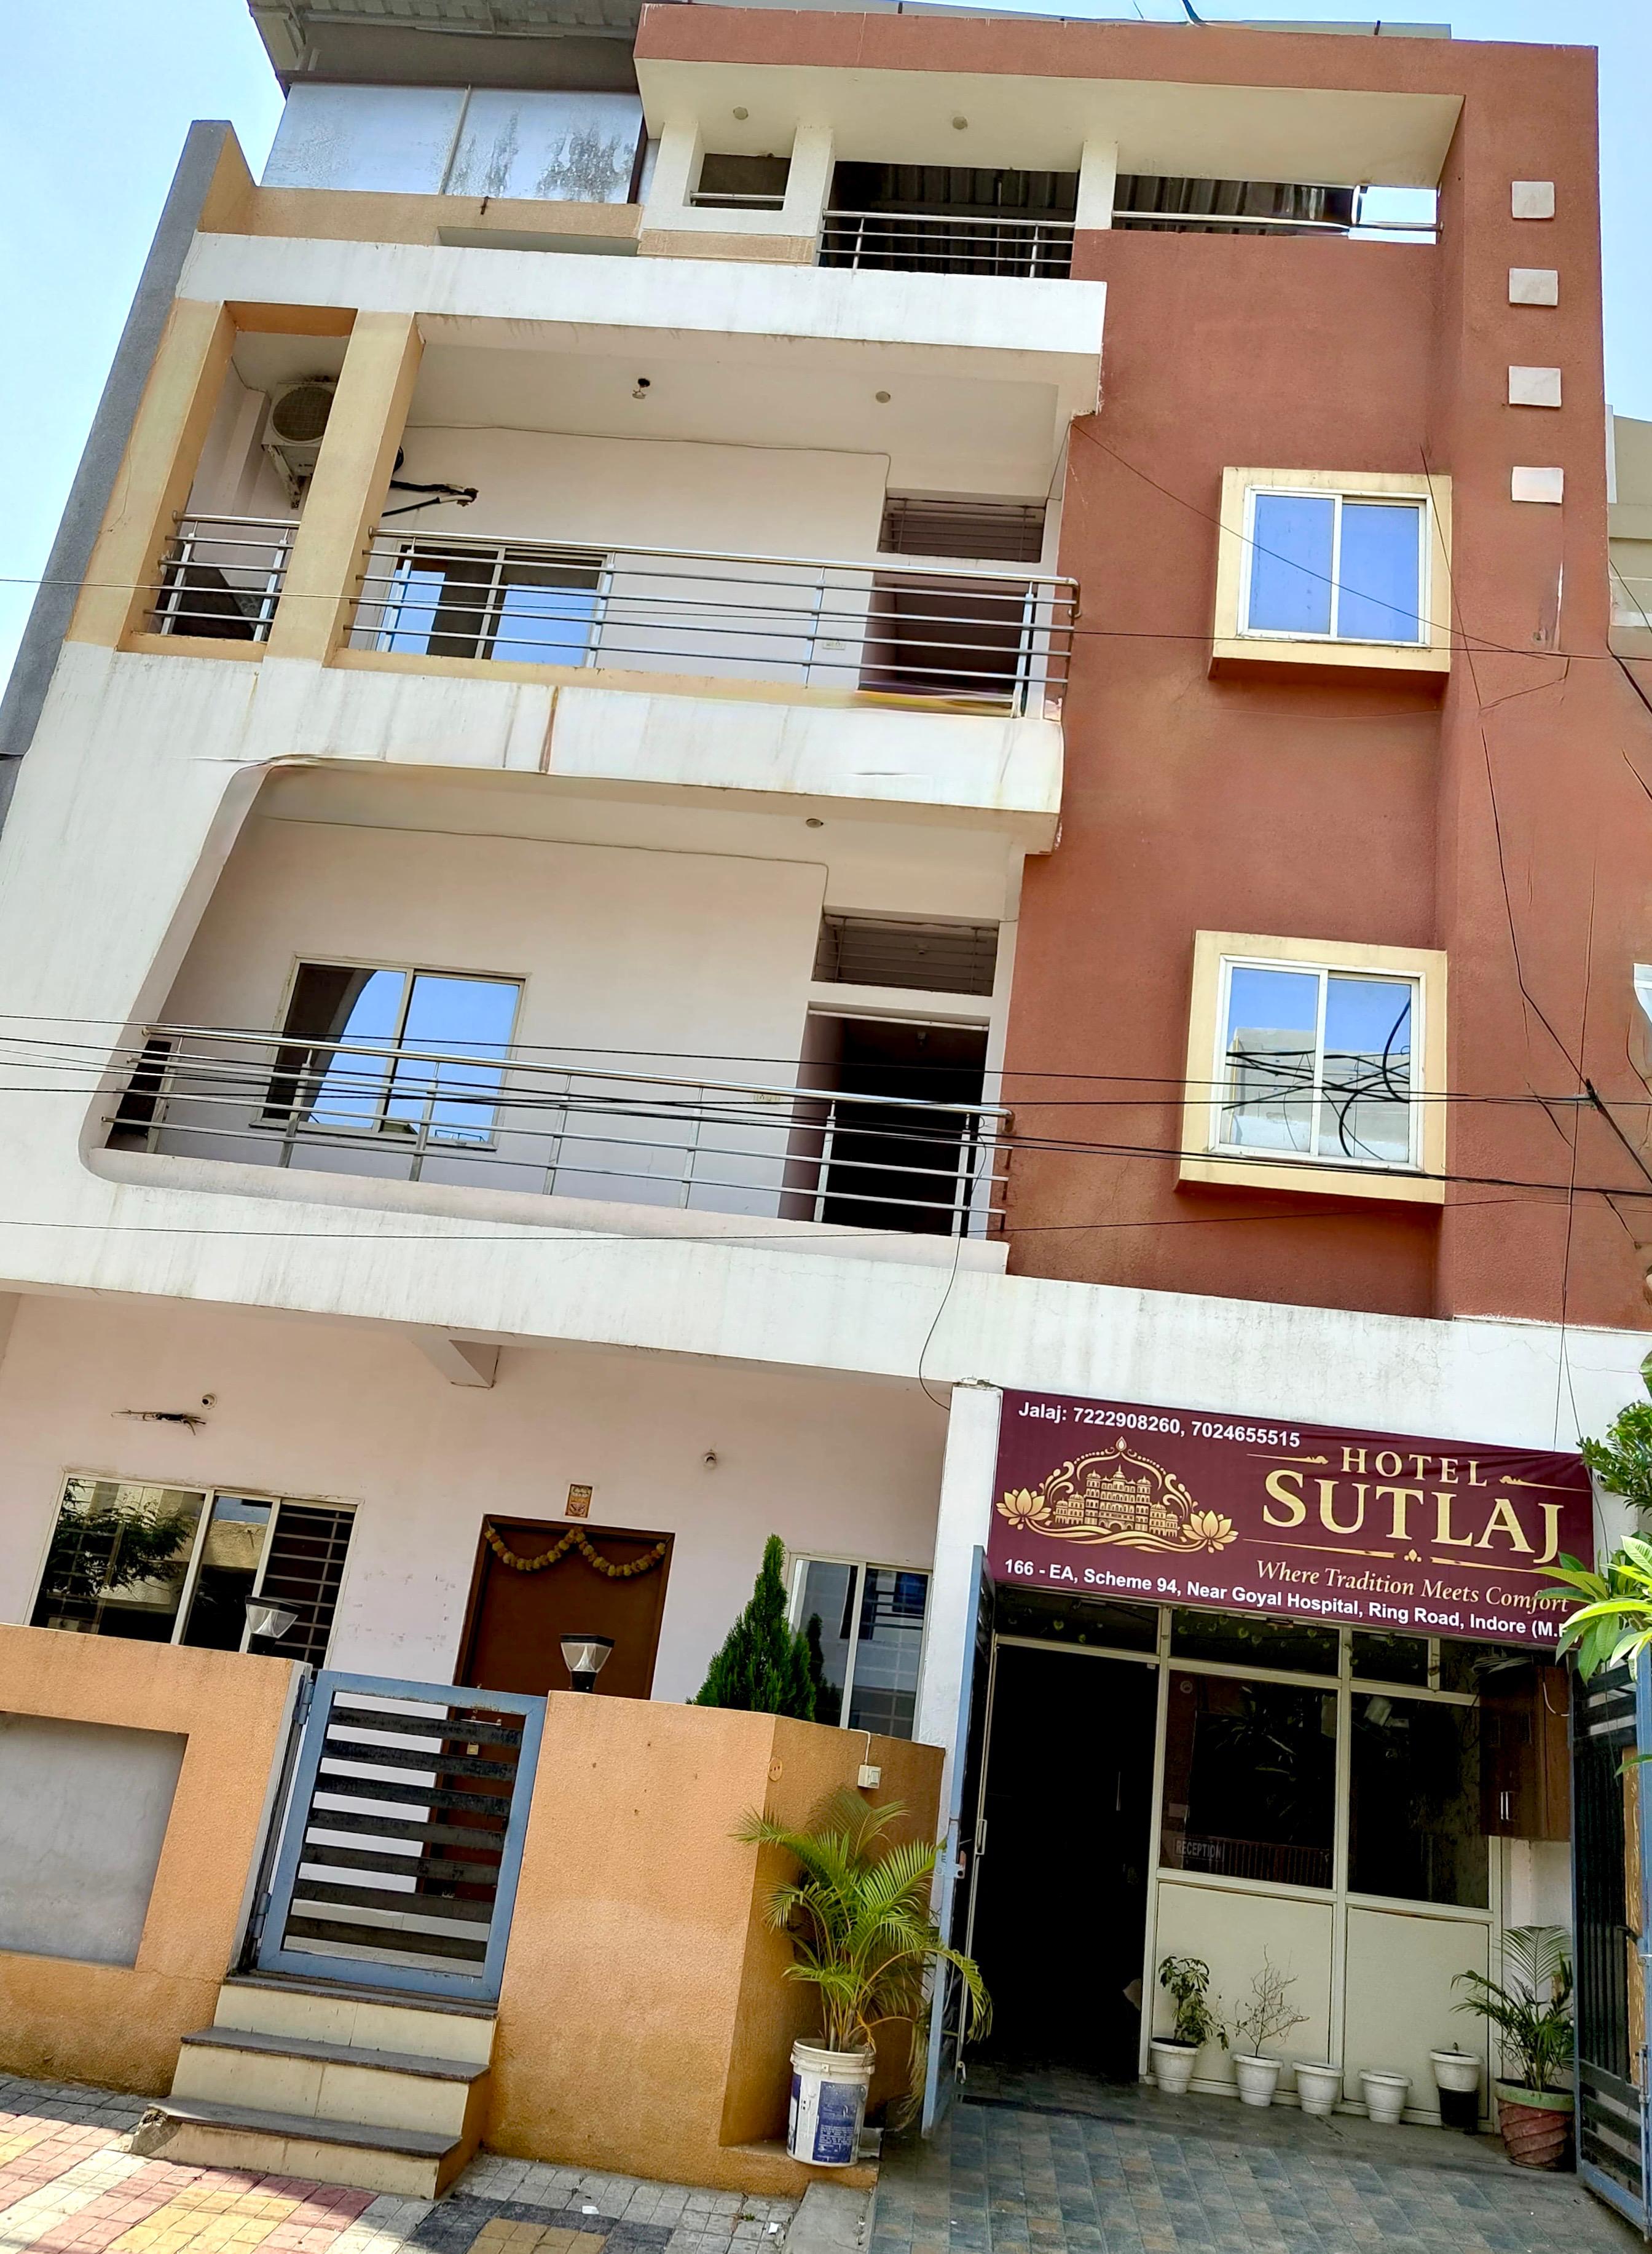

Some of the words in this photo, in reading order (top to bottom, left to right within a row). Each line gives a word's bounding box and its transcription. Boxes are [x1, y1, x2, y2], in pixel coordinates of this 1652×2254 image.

[1018, 1402, 1067, 1424] Jalaj:
[1074, 1408, 1185, 1436] 7222908260,
[1191, 1421, 1300, 1448] 7024655515
[1340, 1446, 1487, 1487] HOTEL
[1262, 1470, 1564, 1564] SUTLAJ
[1005, 1559, 1034, 1575] 166
[1049, 1564, 1078, 1583] EA,
[1084, 1568, 1152, 1590] Scheme
[1157, 1577, 1181, 1597] 94,
[1187, 1581, 1227, 1599] Near
[1232, 1586, 1281, 1607] Goyal
[1287, 1593, 1363, 1618] Hospital,
[1369, 1602, 1409, 1624] Ring
[1414, 1607, 1465, 1629] Road,
[1470, 1614, 1527, 1633] Indore
[1257, 1560, 1320, 1585] Where
[1324, 1567, 1414, 1596] Tradition
[1420, 1578, 1479, 1602] Meets
[1485, 1586, 1568, 1615] Comfort
[1176, 1840, 1221, 1858] RECEPTION
